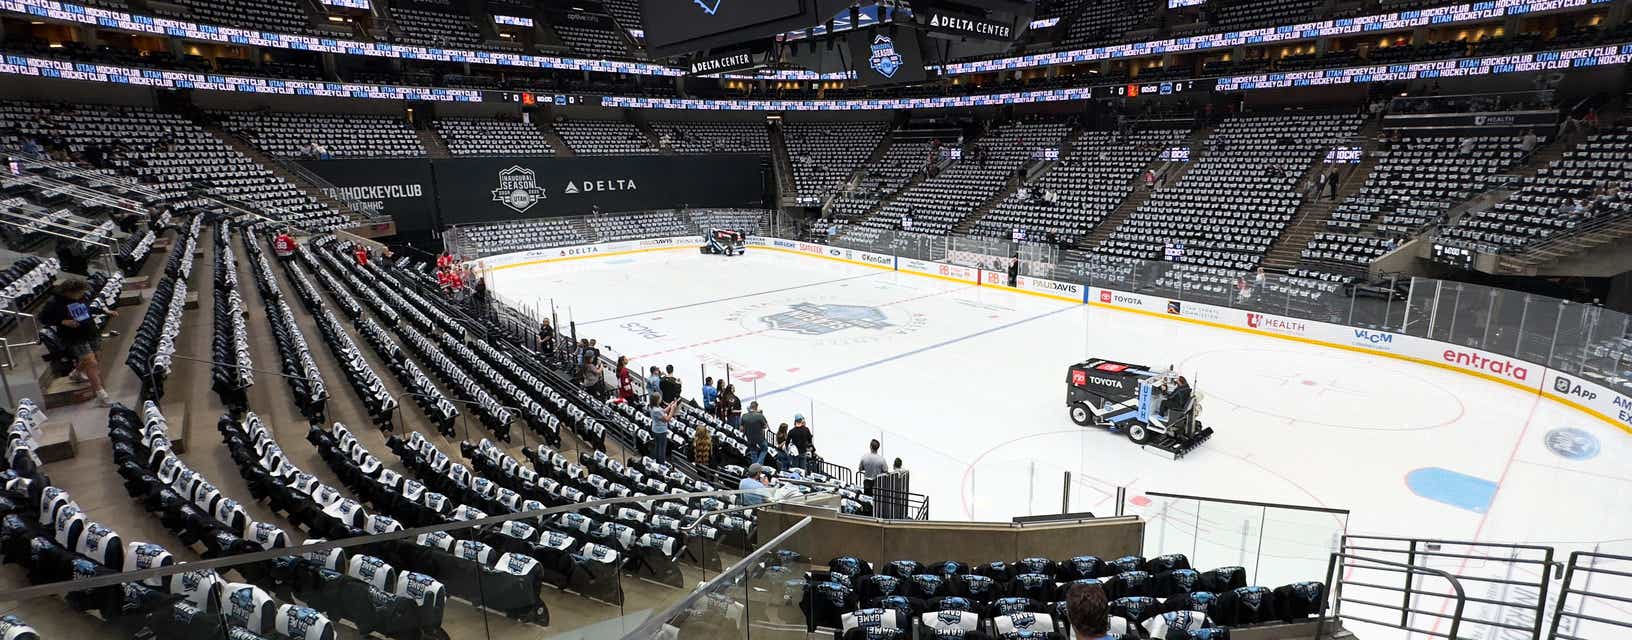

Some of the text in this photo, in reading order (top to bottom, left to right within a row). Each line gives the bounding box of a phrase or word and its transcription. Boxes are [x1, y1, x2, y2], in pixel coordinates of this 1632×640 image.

[6, 0, 272, 46] CLUB UTAH HOCKEY CLUB UTAH HOCKEY CLUB UTAH HOCKEY CLUB UTAH HOCKEY
[63, 3, 84, 14] UTAH
[85, 7, 111, 19] HOCKEY
[112, 11, 130, 22] CLUB
[133, 15, 153, 25] UTAH
[153, 18, 179, 28] HOCKEY
[180, 22, 196, 31] CLUB
[200, 24, 217, 33] UTAH
[218, 26, 242, 36] HOCKEY
[243, 30, 259, 38] CLUB
[261, 32, 278, 40] UTAH
[942, 16, 1010, 38] DELTA CENTER
[1262, 32, 1283, 41] HOCKEY
[1284, 30, 1299, 39] CLUB
[1302, 28, 1318, 37] UTAH
[1319, 26, 1343, 35] HOCKEY
[1344, 24, 1360, 32] CLUB
[1363, 21, 1381, 30] UTAH
[1382, 18, 1408, 28] HOCKEY
[1409, 16, 1428, 25] CLUB
[1431, 13, 1451, 23] UTAH
[1452, 10, 1482, 21] HOCKEY
[1482, 7, 1503, 17] CLUB
[1507, 4, 1529, 14] UTAH
[1530, 0, 1562, 12] HOCKEY
[1277, 25, 1292, 33] UTAH
[1293, 22, 1316, 31] HOCKEY
[1316, 20, 1332, 29] CLUB
[1335, 18, 1352, 27] UTAH
[1353, 15, 1378, 25] HOCKEY
[1379, 13, 1397, 22] CLUB
[1400, 10, 1419, 19] UTAH
[1420, 6, 1448, 17] HOCKEY
[1449, 4, 1469, 14] CLUB
[1473, 1, 1494, 11] UTAH
[7, 55, 26, 66] UTAH
[27, 58, 53, 68] HOCKEY
[54, 61, 72, 70] CLUB
[76, 63, 95, 72] UTAH
[96, 65, 122, 75] HOCKEY
[123, 68, 140, 76] CLUB
[142, 70, 161, 78] UTAH
[162, 72, 187, 80] HOCKEY
[225, 77, 249, 85] HOCKEY
[698, 54, 750, 72] DELTA CENTER
[1310, 76, 1333, 84] HOCKEY
[1353, 74, 1370, 82] UTAH
[1371, 72, 1398, 80] HOCKEY
[1398, 70, 1416, 79] CLUB
[1420, 69, 1438, 77] UTAH
[1440, 66, 1468, 76] HOCKEY
[1469, 65, 1488, 74] CLUB
[1492, 63, 1513, 72] UTAH
[1514, 60, 1546, 71] HOCKEY
[1547, 58, 1568, 68] CLUB
[1573, 56, 1596, 66] UTAH
[1597, 53, 1631, 64] HOCKEY
[1343, 67, 1368, 76] HOCKEY
[1369, 66, 1386, 74] CLUB
[1389, 64, 1407, 72] UTAH
[1408, 62, 1436, 71] HOCKEY
[1437, 60, 1455, 69] CLUB
[1459, 58, 1479, 67] UTAH
[1480, 56, 1510, 66] HOCKEY
[1511, 54, 1532, 63] CLUB
[1536, 52, 1558, 61] UTAH
[1559, 48, 1593, 59] HOCKEY
[1594, 46, 1616, 56] CLUB
[20, 65, 39, 75] CLUB
[41, 67, 59, 77] UTAH
[60, 69, 87, 79] HOCKEY
[88, 72, 107, 81] CLUB
[110, 74, 127, 83] UTAH
[128, 75, 153, 85] HOCKEY
[155, 78, 173, 86] CLUB
[176, 79, 192, 87] UTAH
[193, 81, 217, 89] HOCKEY
[502, 181, 534, 190] SEASON
[584, 180, 636, 192] DELTA
[569, 247, 598, 255] DELTA
[1114, 295, 1142, 305] TOYOTA
[1265, 318, 1305, 331] HEALTH
[1443, 349, 1527, 380] entrata
[1089, 376, 1122, 388] TOYOTA
[1571, 385, 1597, 400] App
[858, 614, 880, 623] GAME
[937, 629, 963, 637] GAME
